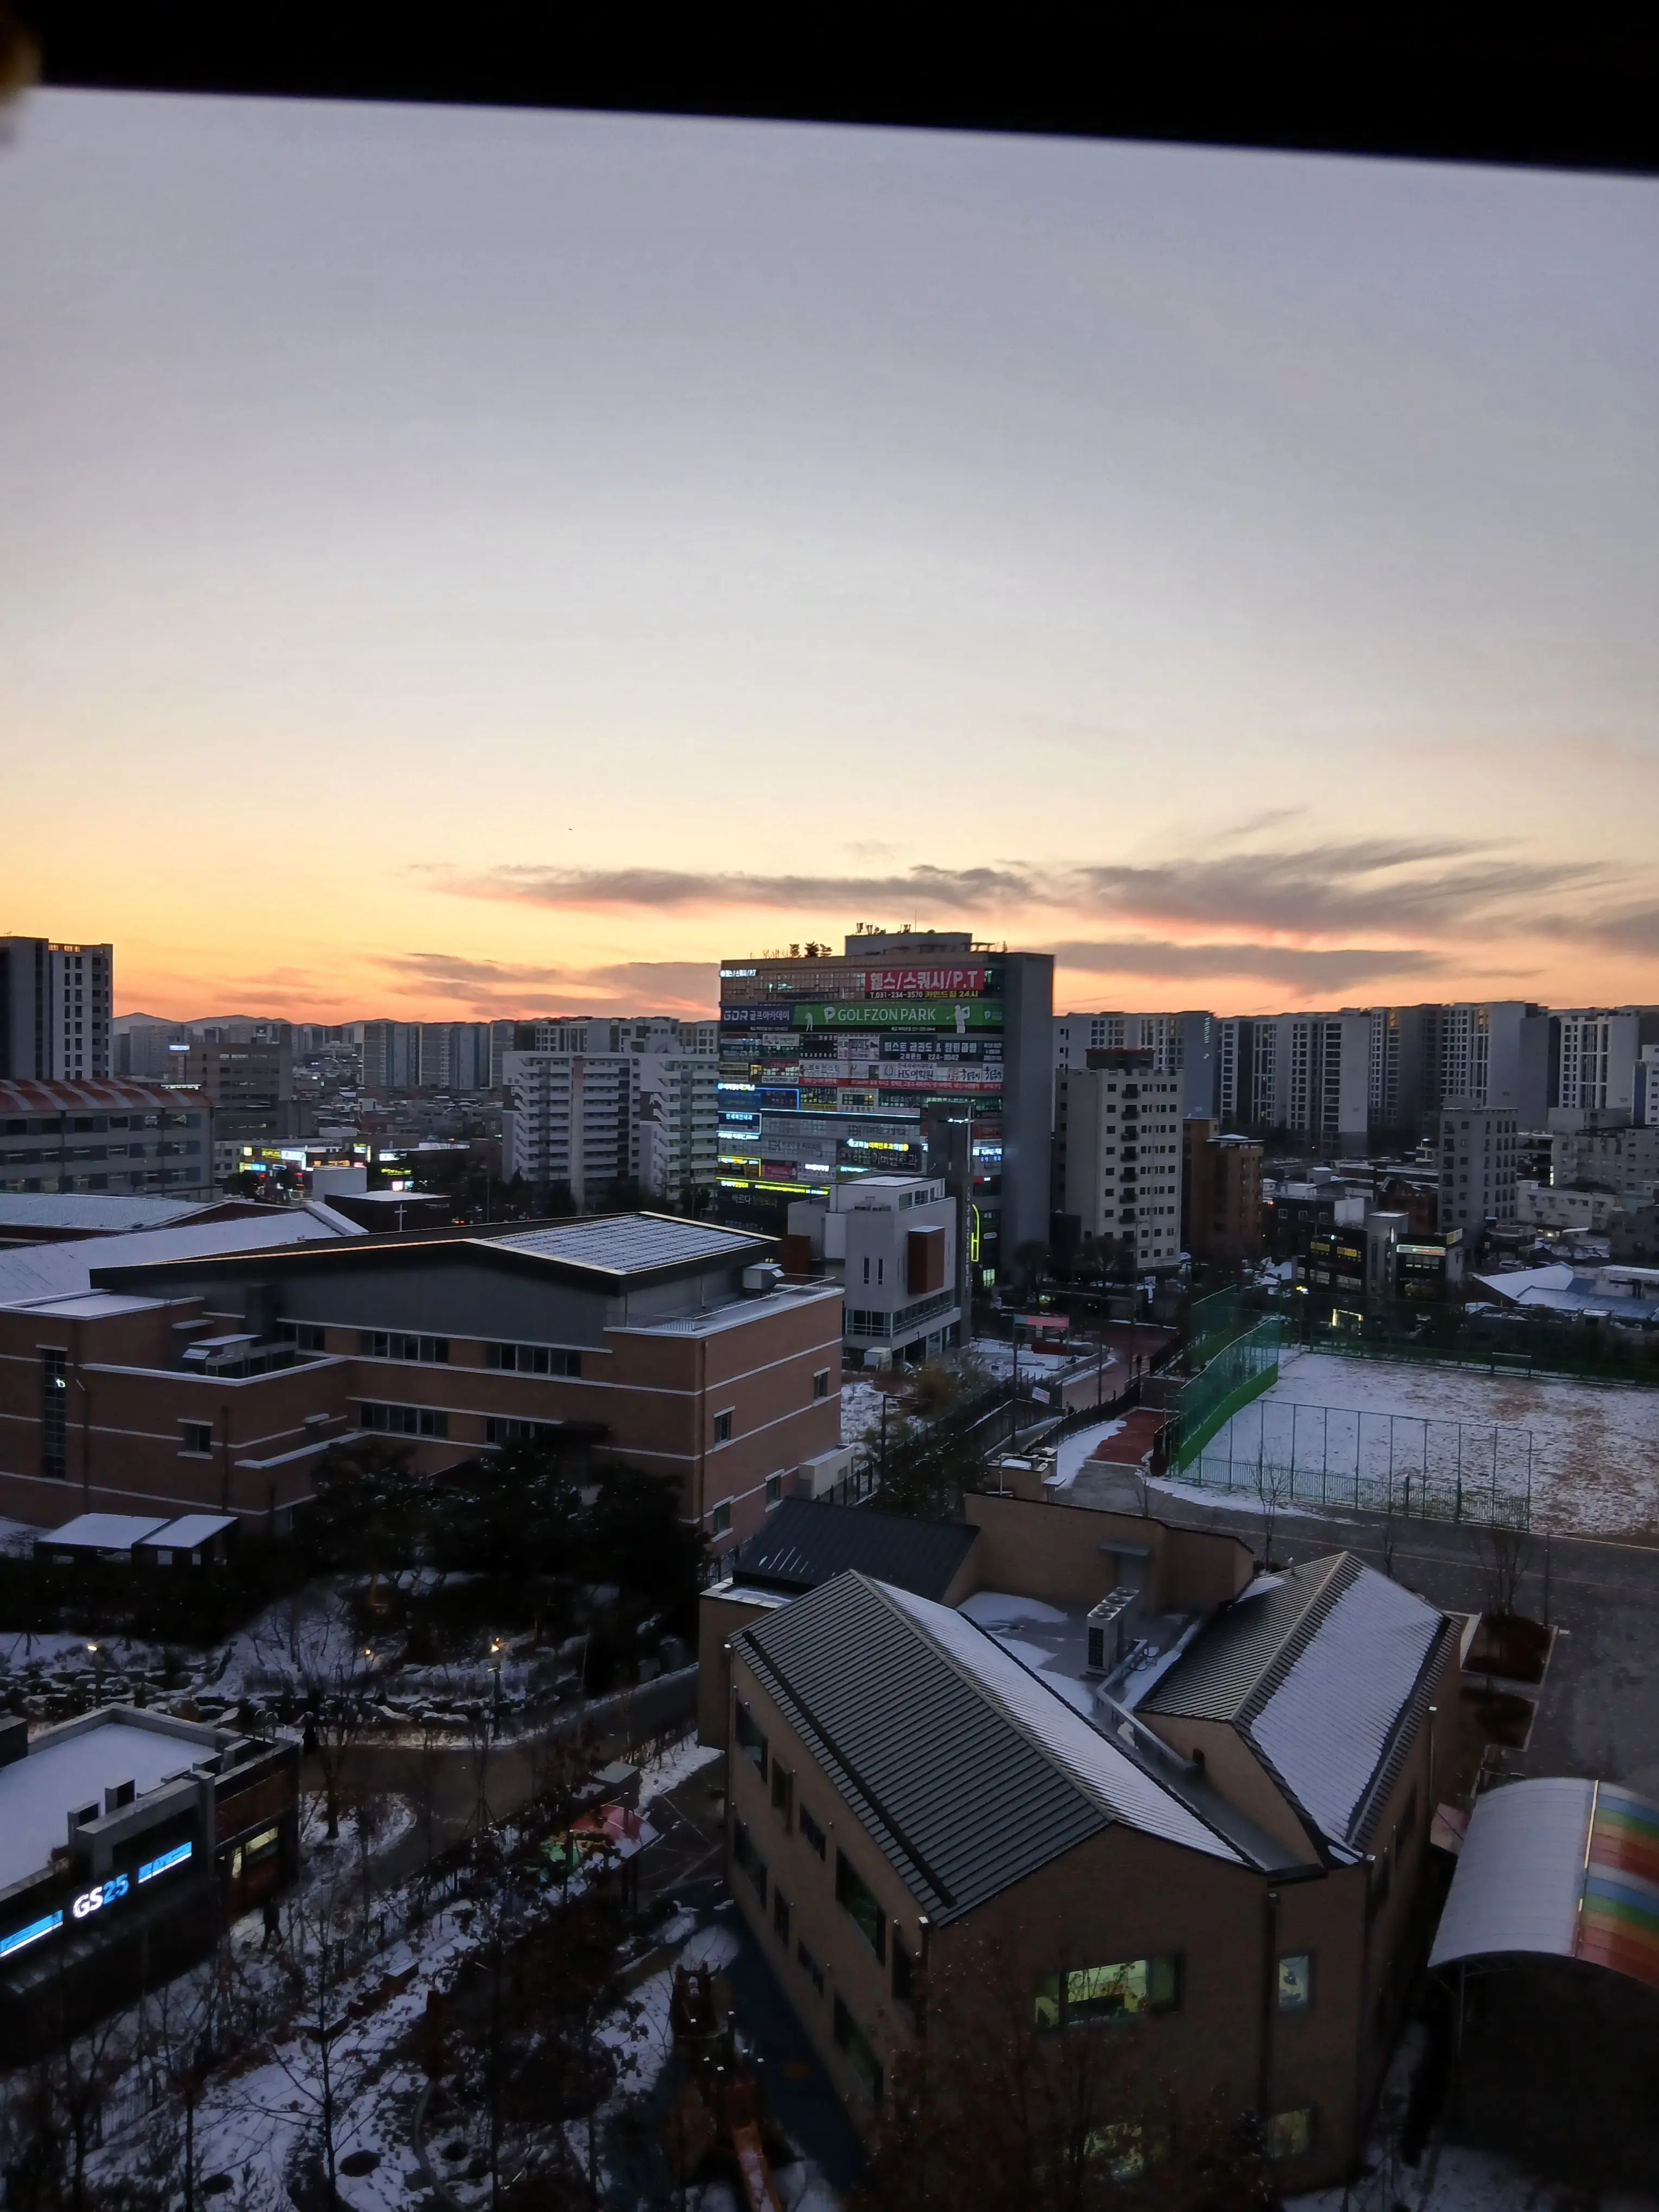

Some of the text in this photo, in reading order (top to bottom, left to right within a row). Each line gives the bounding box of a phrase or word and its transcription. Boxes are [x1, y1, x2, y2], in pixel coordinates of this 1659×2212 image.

[724, 1010, 790, 1021] GDR 골프아카데미
[837, 1008, 936, 1021] GOLFZON PARK
[73, 1873, 129, 1918] GS25
